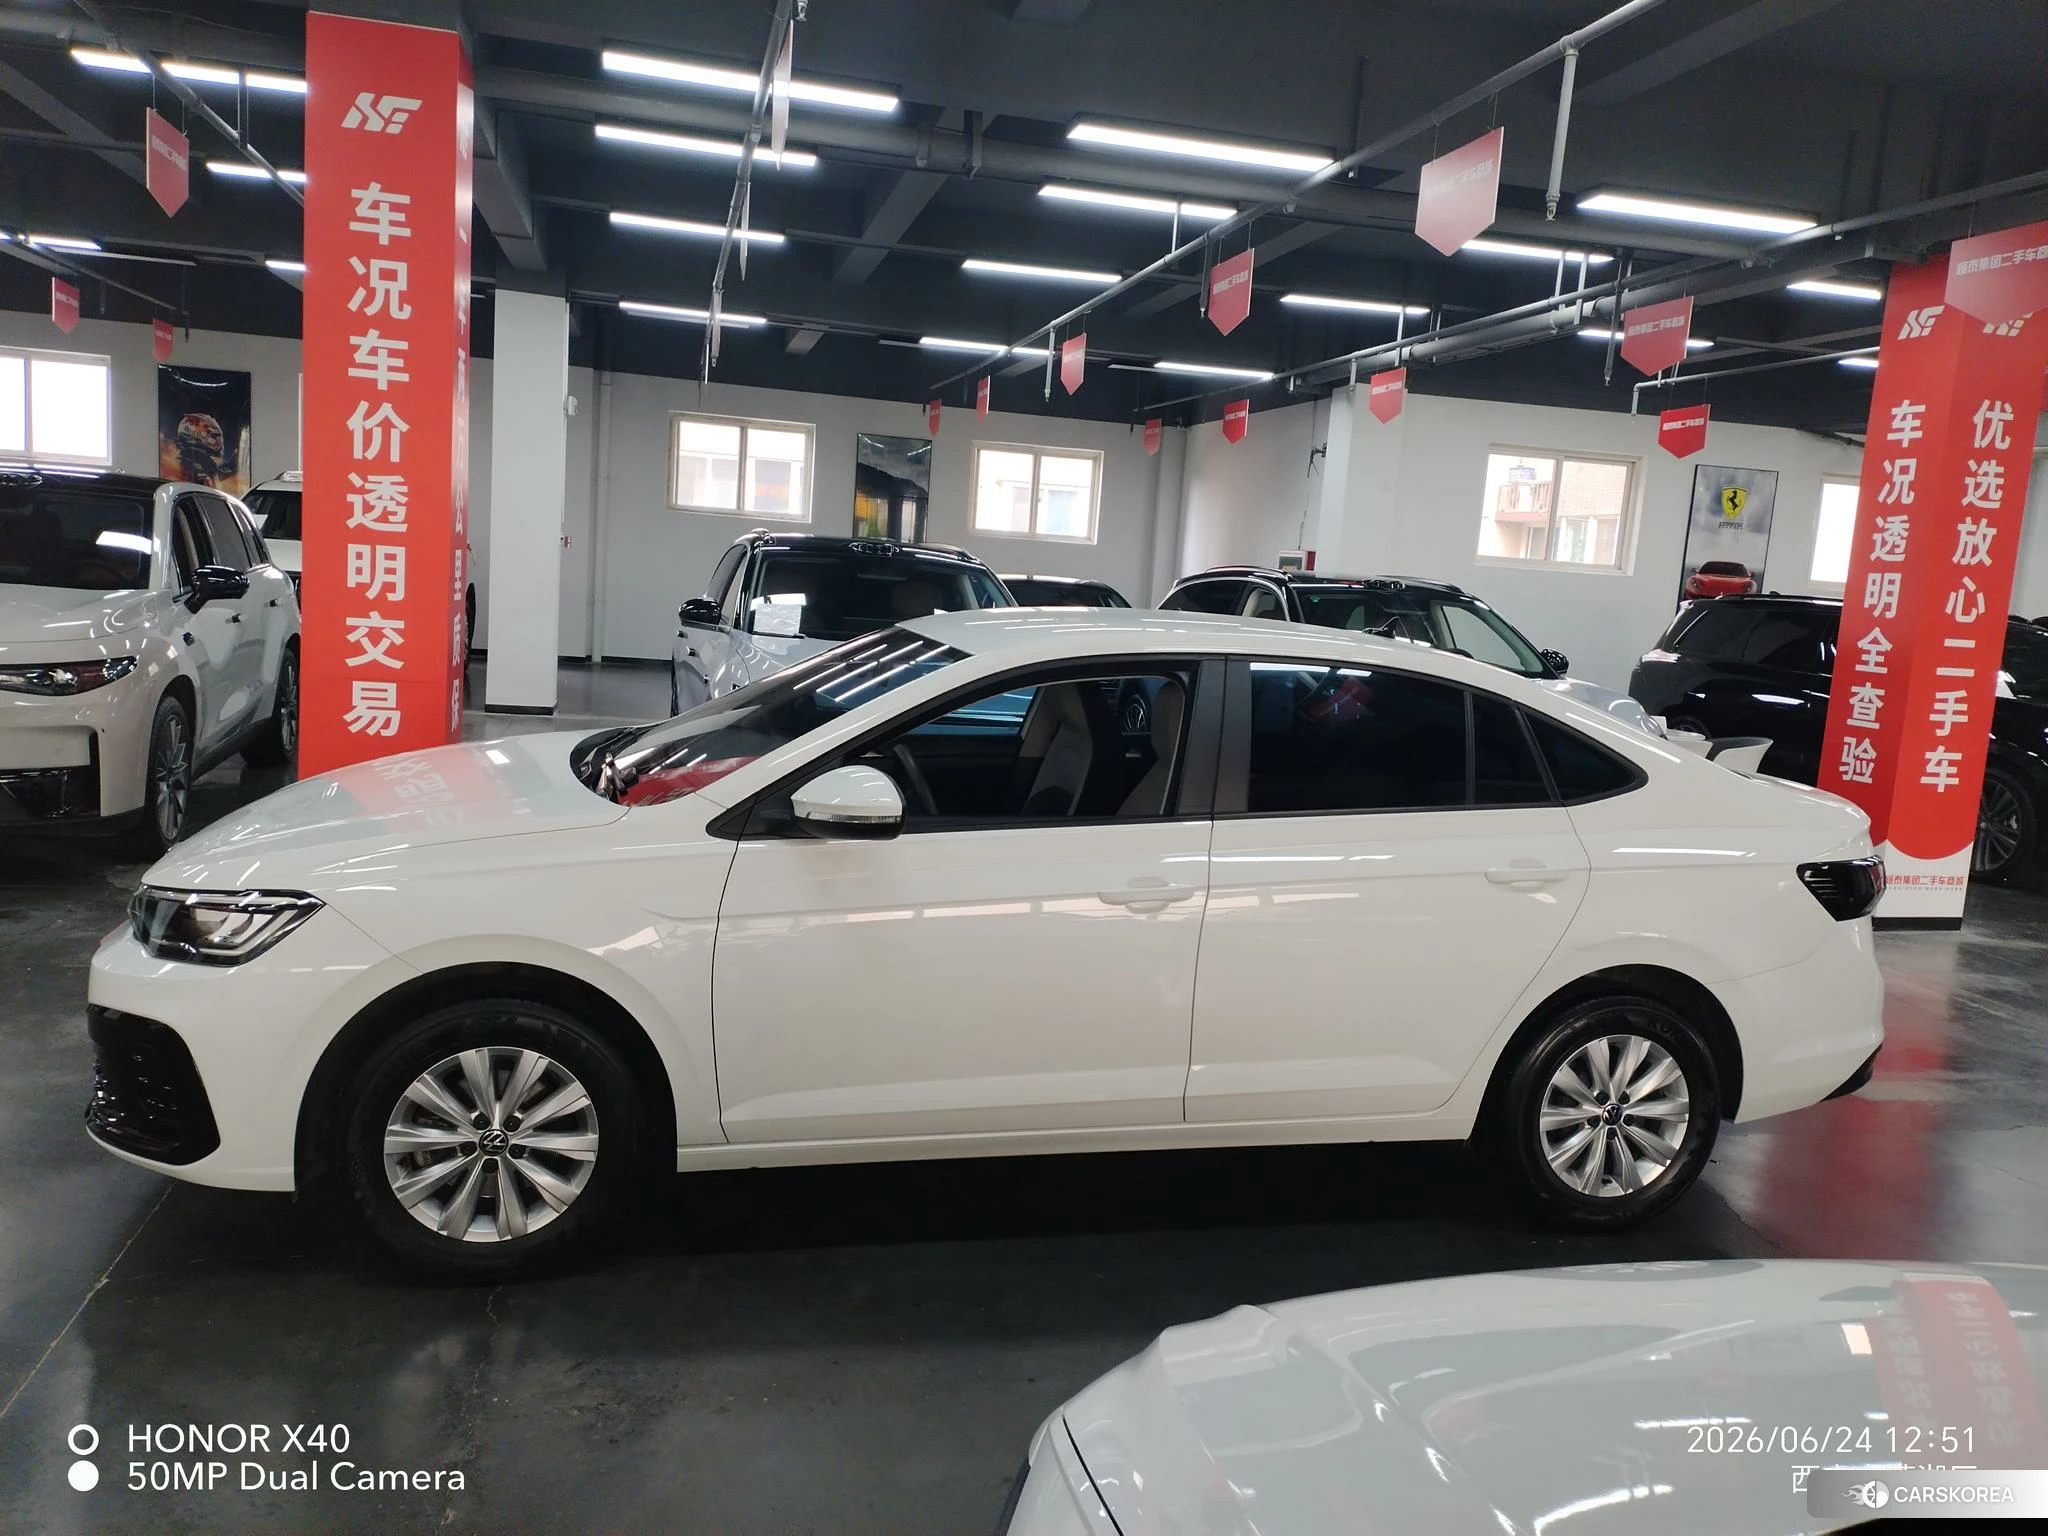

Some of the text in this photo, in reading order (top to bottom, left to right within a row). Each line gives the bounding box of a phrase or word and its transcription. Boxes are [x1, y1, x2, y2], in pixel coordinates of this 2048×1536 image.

[343, 182, 412, 737] 车况车价透明交易
[1838, 399, 1927, 784] 车况透明全查验
[1919, 399, 2015, 793] 优选放心二手车
